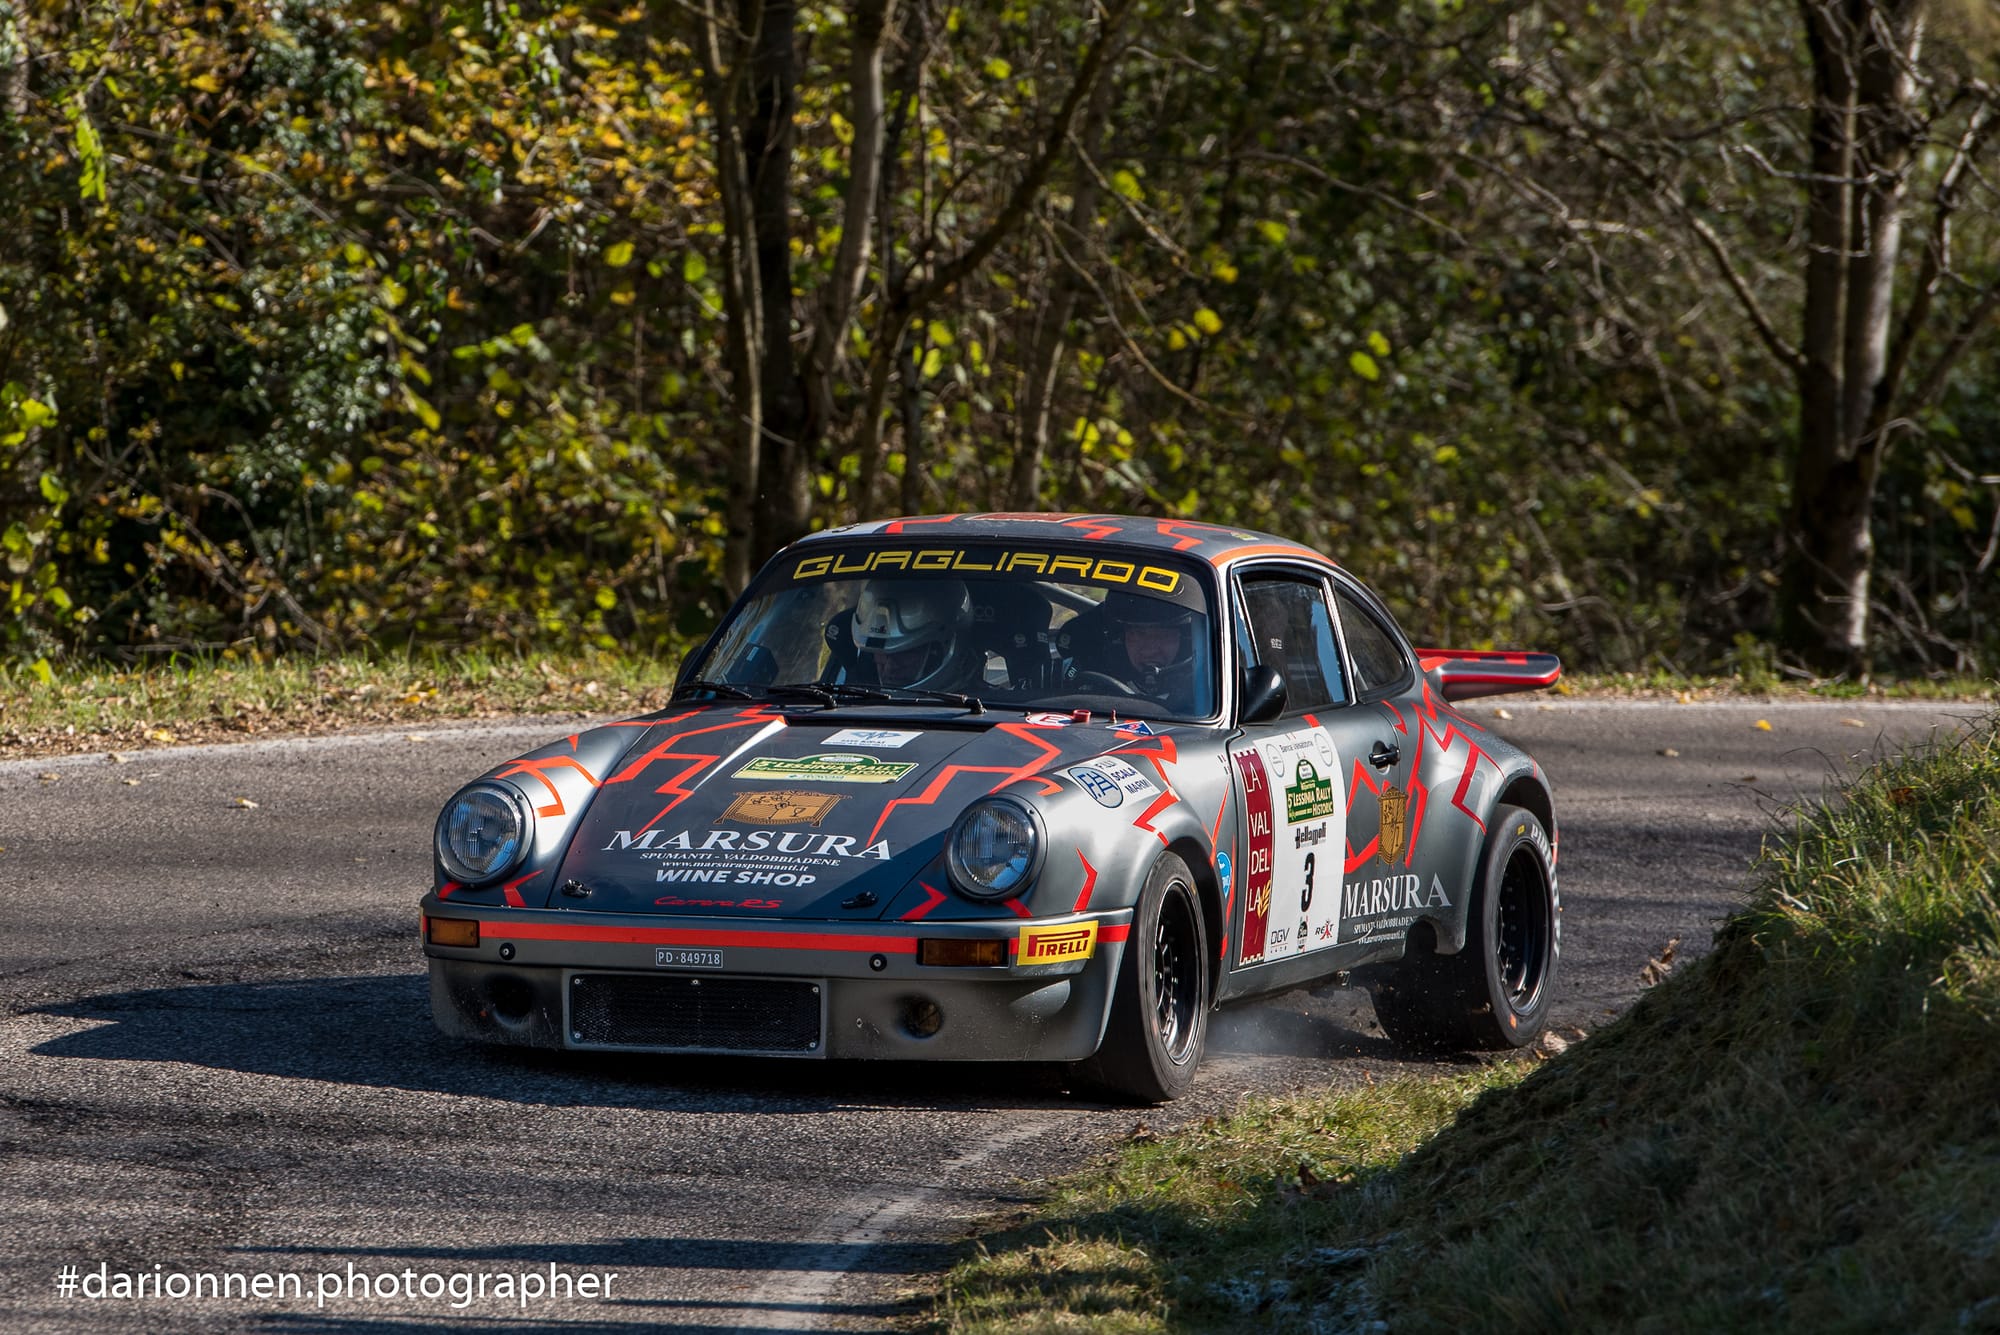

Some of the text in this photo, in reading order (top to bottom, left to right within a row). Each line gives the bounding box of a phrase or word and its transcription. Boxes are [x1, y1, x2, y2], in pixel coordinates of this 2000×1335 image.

[792, 549, 1184, 593] GUAGLIARDO
[1240, 760, 1261, 792] LA
[1250, 811, 1270, 838] VAL
[601, 830, 893, 861] MARSURA
[640, 852, 713, 861] SPUMANTI
[724, 853, 840, 867] VALDOBBIADENE
[662, 861, 809, 872] www.marsuraspumanti.it
[1251, 848, 1270, 875] DEL
[656, 869, 817, 887] WINE SHOP
[1301, 852, 1315, 913] 3
[1342, 872, 1452, 919] MARSURA
[1027, 930, 1091, 957] PIRELLI
